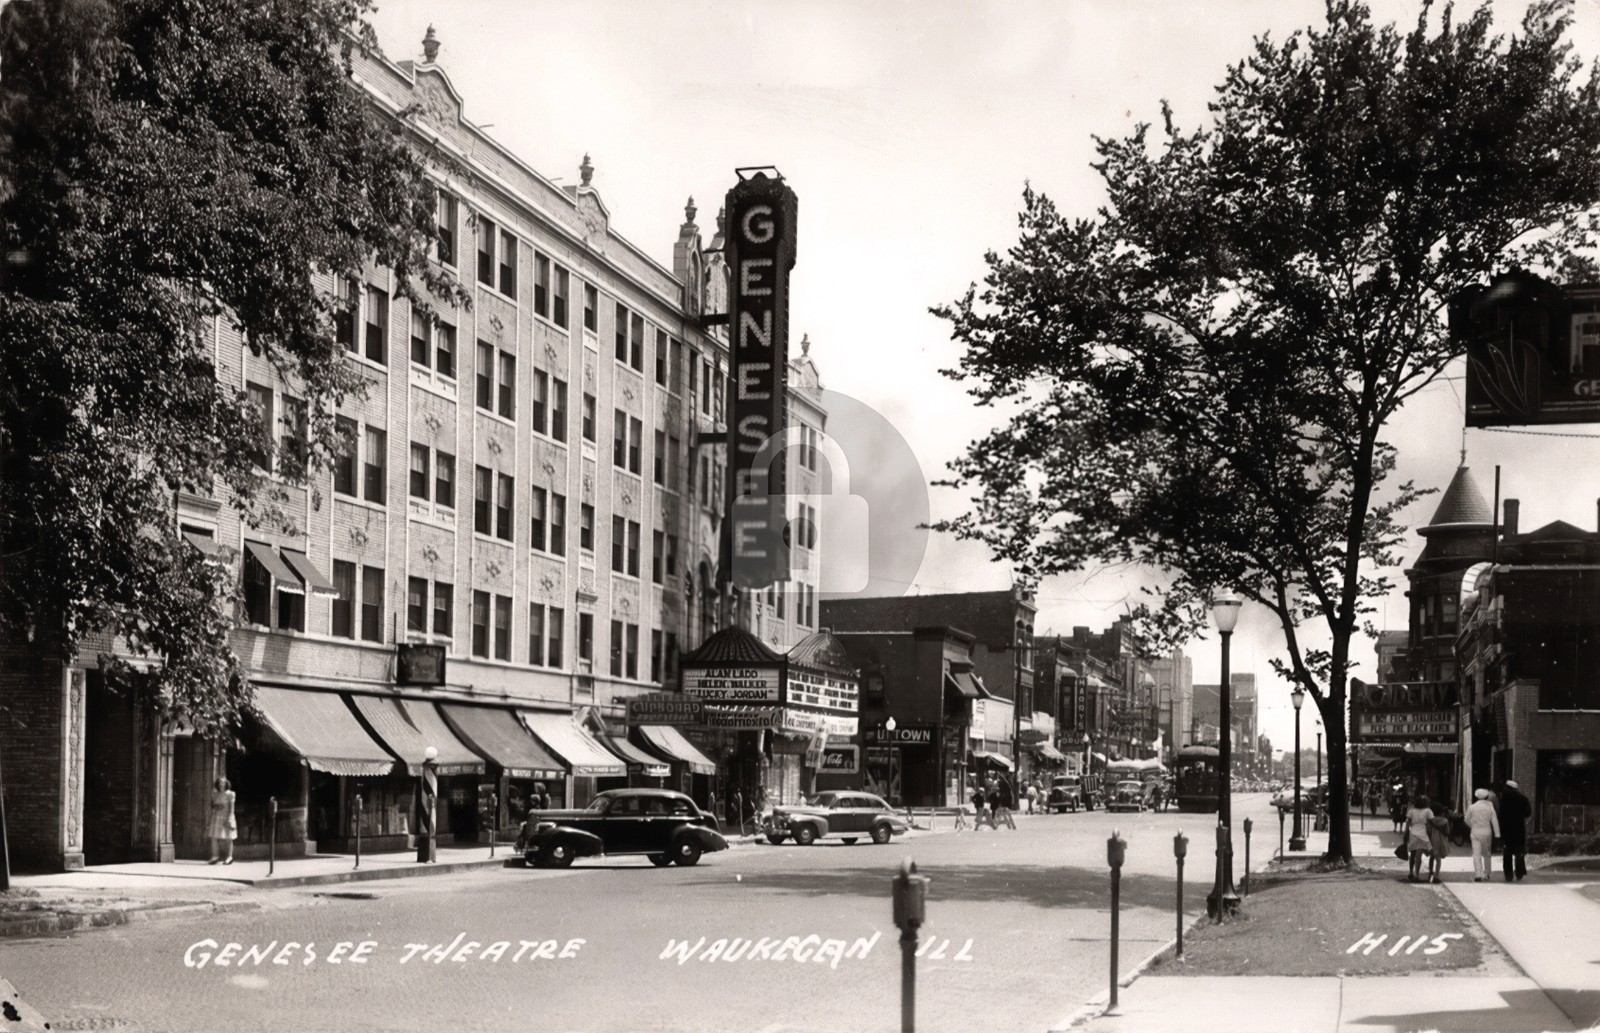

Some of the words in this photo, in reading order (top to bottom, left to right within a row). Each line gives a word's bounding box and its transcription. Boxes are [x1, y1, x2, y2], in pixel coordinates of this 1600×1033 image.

[735, 205, 775, 557] GENESEE
[705, 669, 731, 678] ALAN
[730, 680, 767, 689] WALKER
